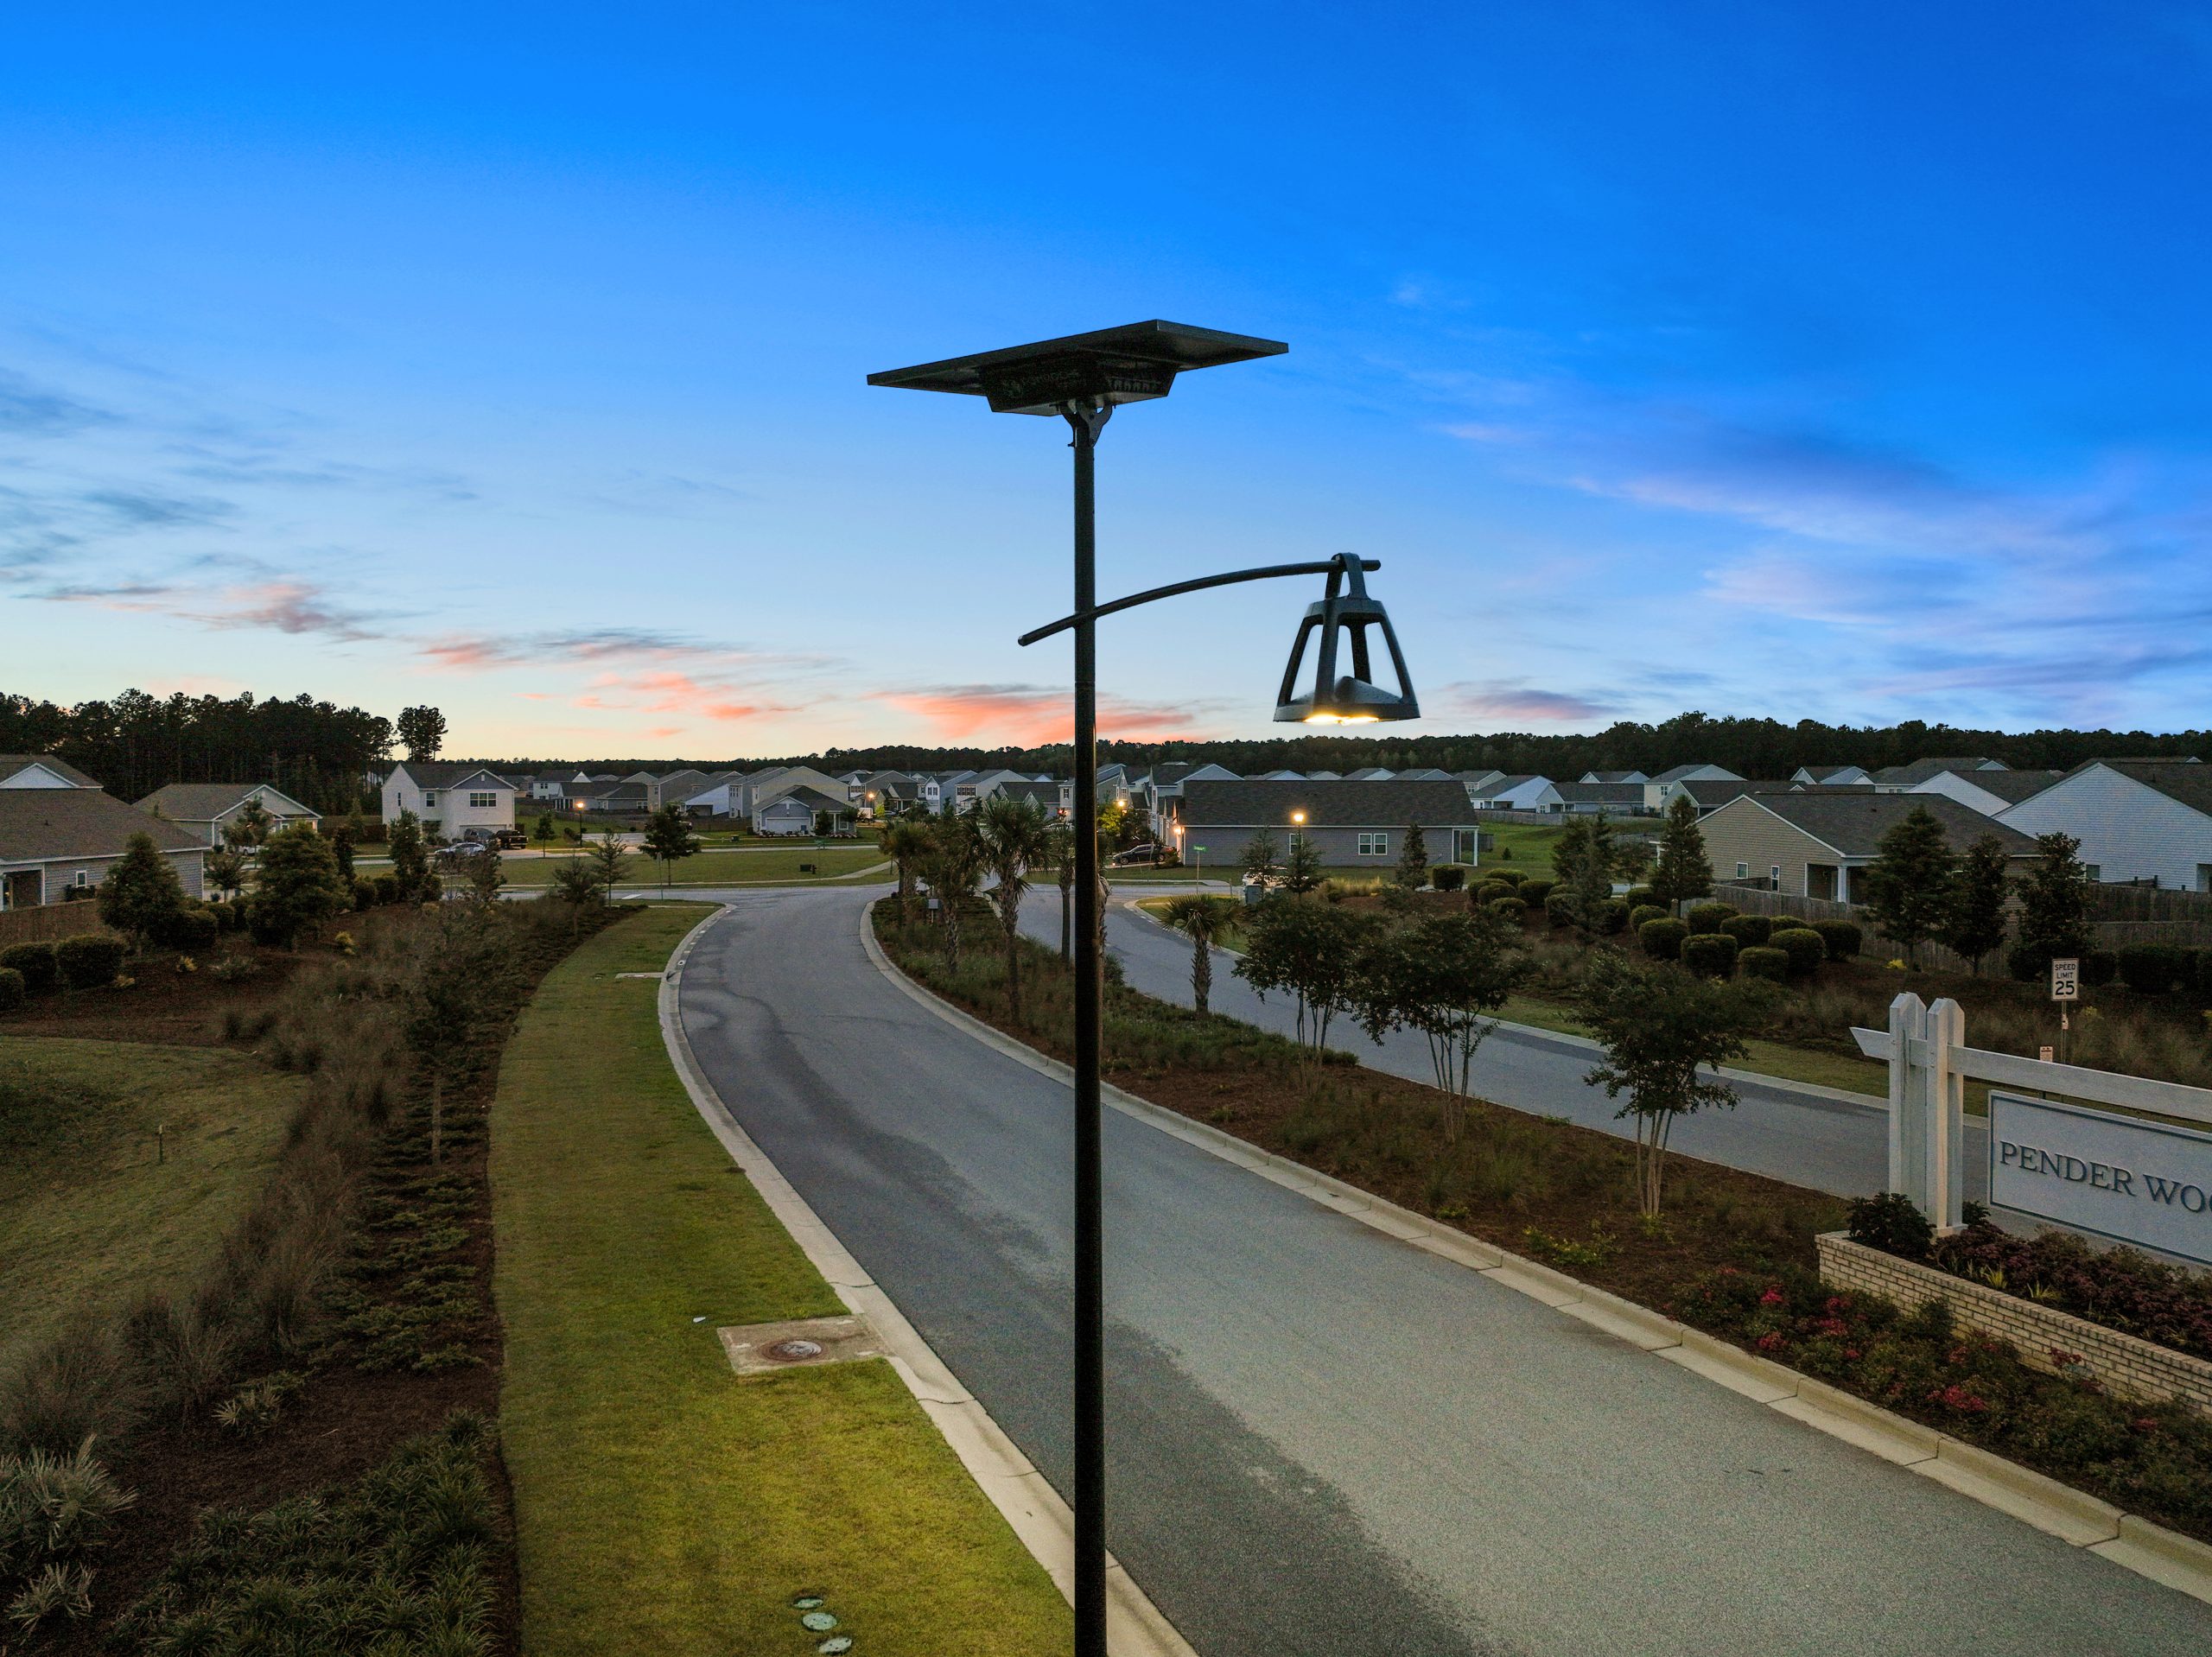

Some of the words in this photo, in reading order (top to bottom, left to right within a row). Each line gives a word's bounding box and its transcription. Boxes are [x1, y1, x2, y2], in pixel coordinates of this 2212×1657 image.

[2055, 981, 2075, 995] 25
[1999, 1140, 2137, 1197] PENDER
[2142, 1173, 2212, 1213] WO
